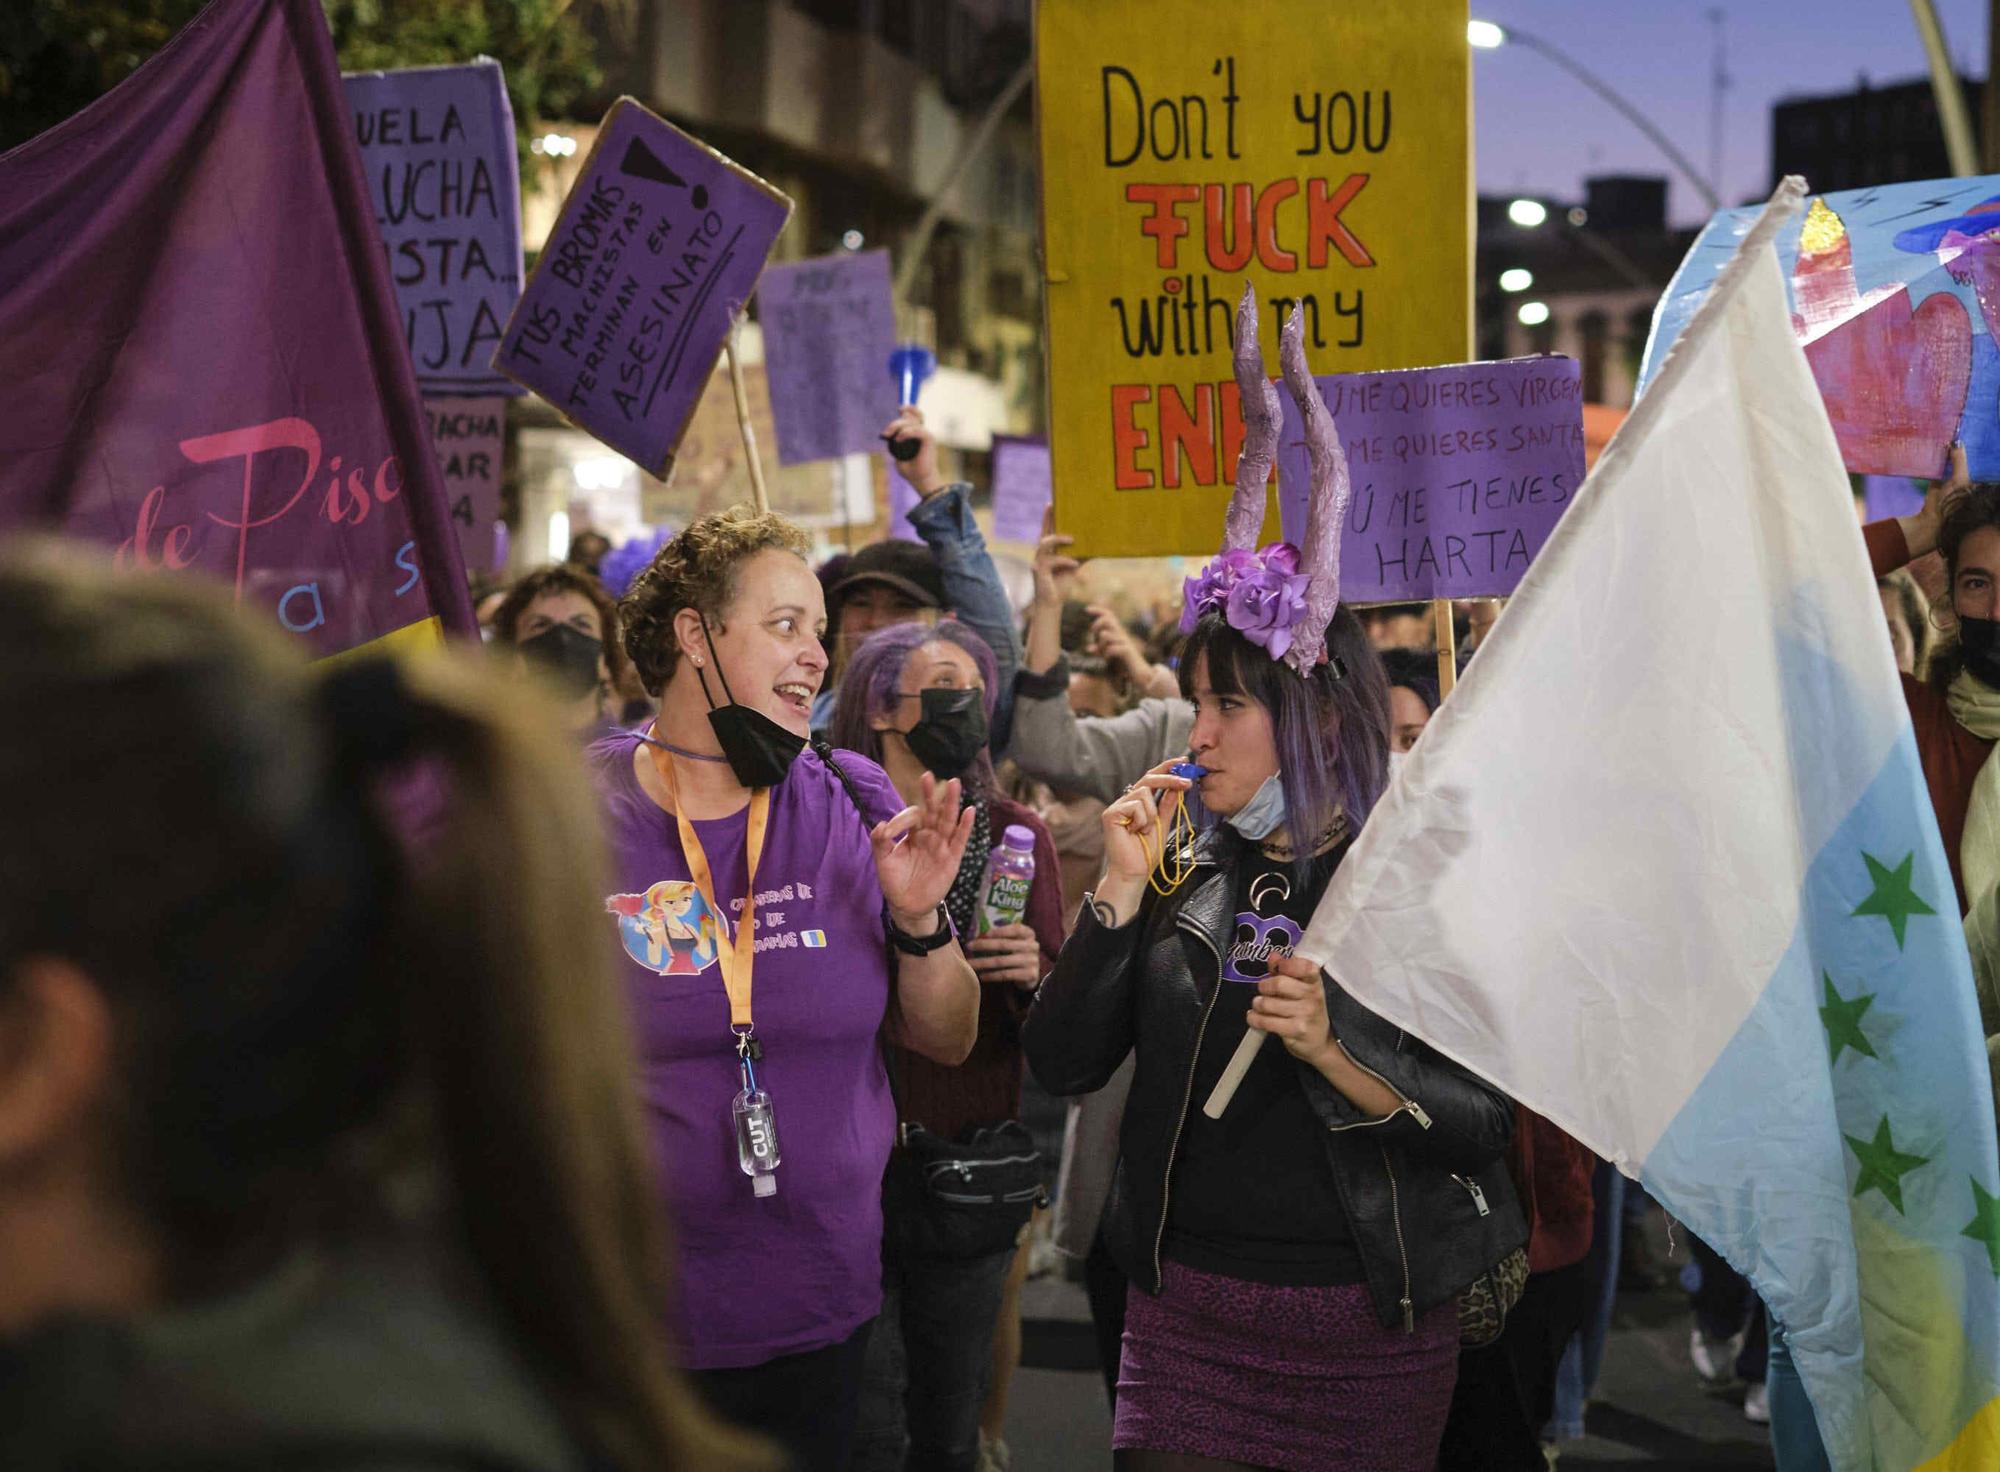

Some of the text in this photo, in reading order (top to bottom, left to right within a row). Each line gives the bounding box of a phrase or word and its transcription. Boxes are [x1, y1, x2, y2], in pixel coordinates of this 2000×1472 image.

[356, 104, 466, 146] UELA
[1102, 57, 1392, 168] Don't you
[377, 157, 498, 225] UCHA
[1125, 173, 1377, 273] FUCK
[510, 175, 625, 365] TUS BROMAS
[560, 201, 643, 358] MACHISTAS
[569, 216, 672, 407] TERMINAN EN
[612, 210, 723, 421] ASESINATO
[1110, 274, 1365, 358] with my
[1349, 383, 1382, 413] ME
[1392, 378, 1500, 414] QUIERES
[1349, 437, 1383, 465] ME
[1392, 428, 1498, 464] QUIERES
[1506, 423, 1584, 452] SANTA
[1387, 487, 1427, 528] ME
[1447, 474, 1569, 516] TIENES
[1375, 528, 1531, 587] HARTA
[991, 890, 1027, 910] King
[993, 877, 1029, 895] Aloe
[747, 1117, 769, 1158] CUT
